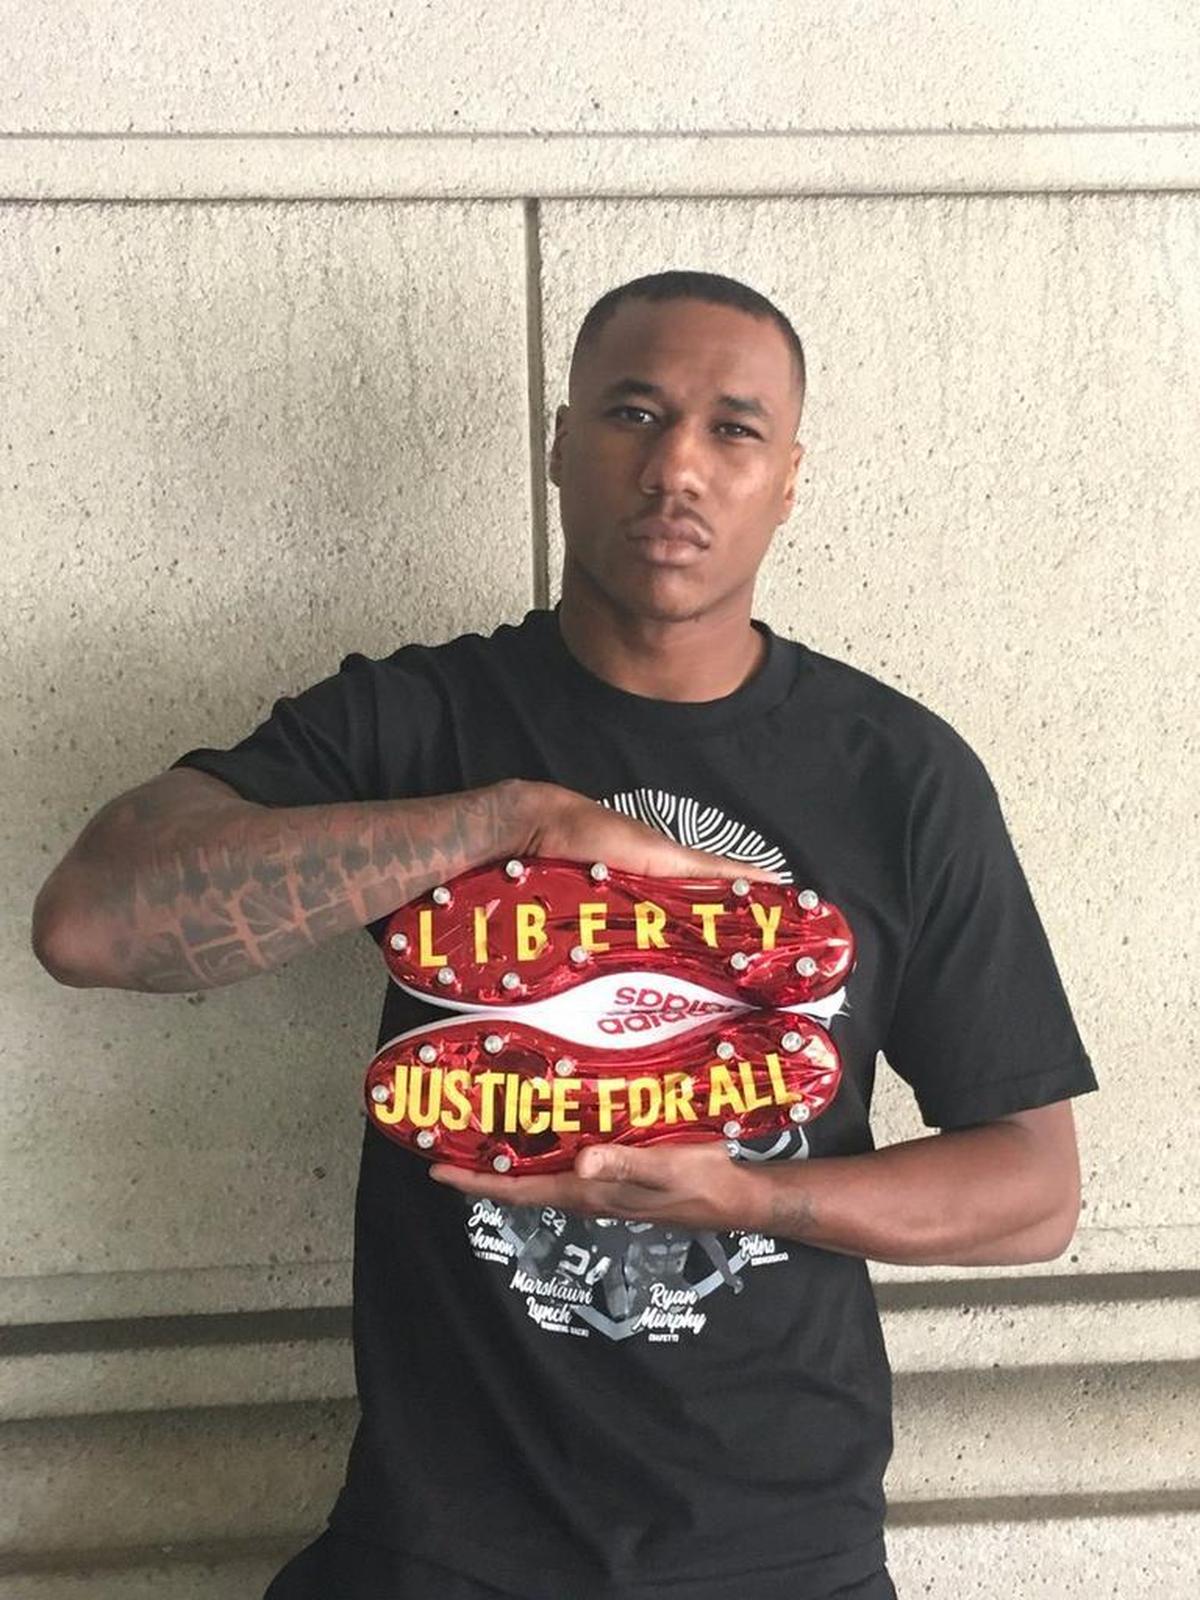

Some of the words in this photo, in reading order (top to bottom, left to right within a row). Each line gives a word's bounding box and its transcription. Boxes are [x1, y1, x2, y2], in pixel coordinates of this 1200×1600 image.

[419, 901, 782, 967] LIBERTY
[374, 1065, 582, 1134] JUSTICE
[597, 1071, 698, 1132] FOR
[708, 1053, 802, 1116] ALL
[468, 1202, 504, 1228] Josh
[509, 1268, 593, 1304] Marshawn
[650, 1283, 697, 1310] Ryan
[526, 1296, 572, 1324] Lynch
[632, 1307, 707, 1334] Murphy
